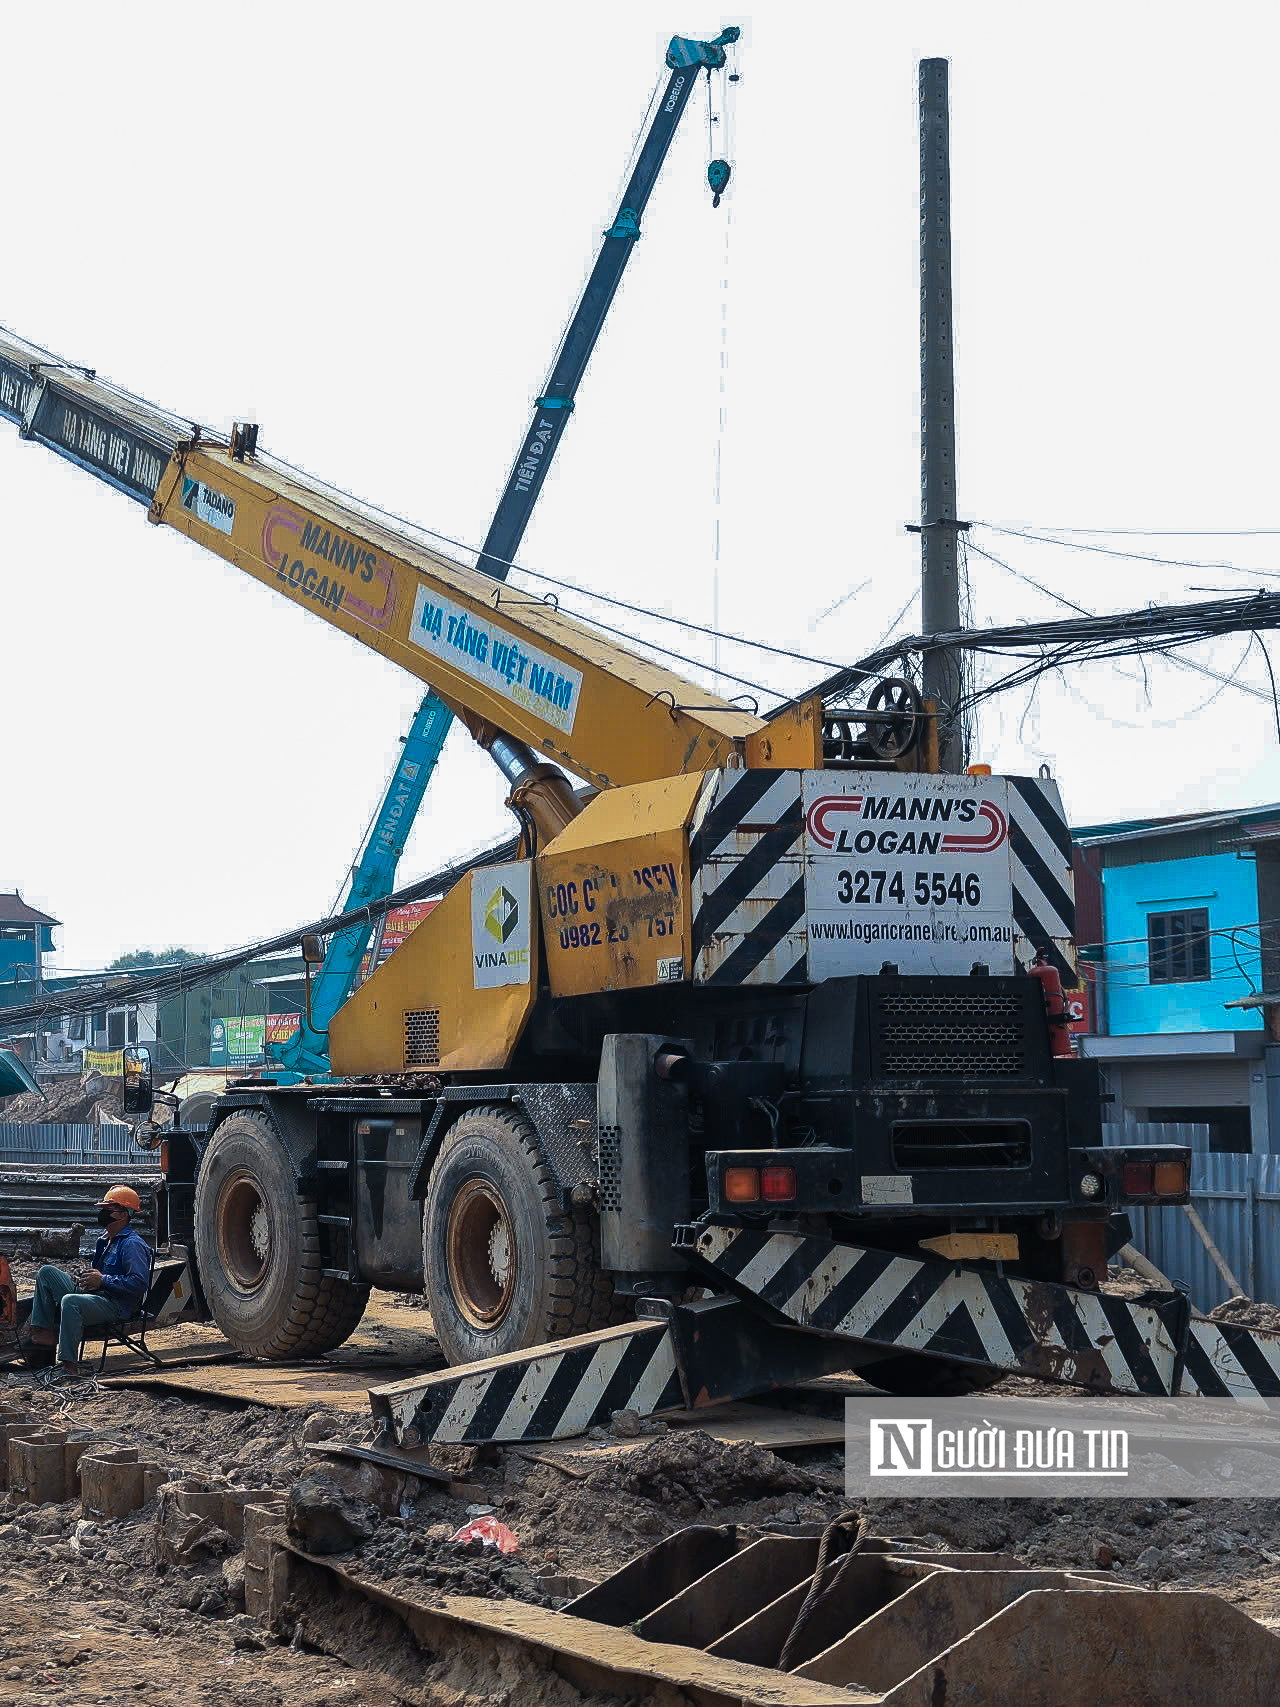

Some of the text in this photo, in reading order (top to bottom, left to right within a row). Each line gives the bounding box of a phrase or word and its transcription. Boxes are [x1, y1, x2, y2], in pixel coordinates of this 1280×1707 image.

[664, 75, 685, 113] KOBELCO
[131, 447, 162, 492] NAM
[203, 487, 234, 519] TADANO
[300, 519, 377, 583] MANN'S
[276, 552, 346, 613] LOGAN
[420, 600, 444, 641] HẠ
[446, 612, 490, 664] TẦNG
[490, 640, 529, 685] VIỆT
[529, 663, 574, 710] NAM
[861, 796, 978, 822] MANN'S
[835, 829, 942, 855] LOGAN
[837, 869, 981, 907] 3274 5546
[559, 922, 603, 950] 0982
[643, 911, 675, 938] 757
